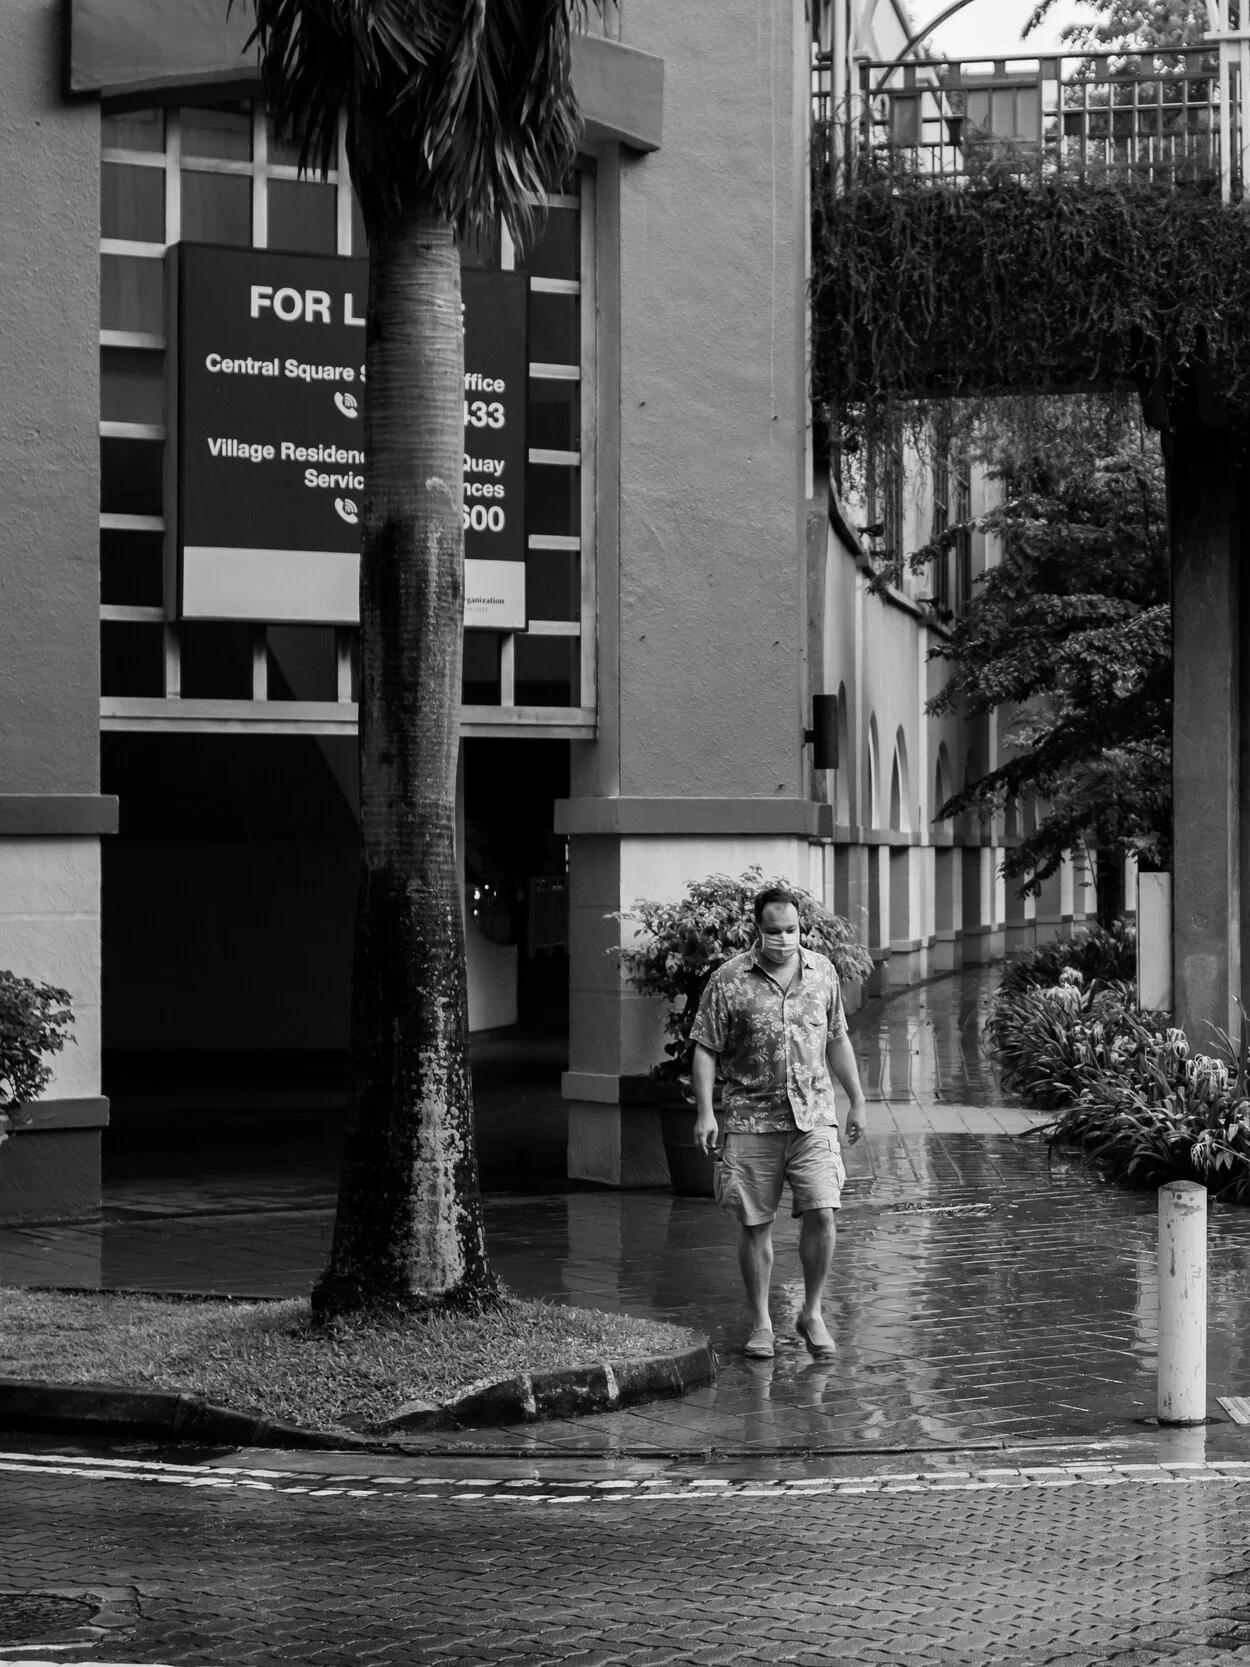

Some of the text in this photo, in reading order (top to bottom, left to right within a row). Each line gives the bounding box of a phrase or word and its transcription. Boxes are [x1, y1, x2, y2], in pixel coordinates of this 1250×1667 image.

[250, 285, 331, 324] FOR
[205, 353, 279, 376] Central
[284, 358, 355, 382] Square
[463, 372, 505, 393] ffice
[207, 437, 275, 463] Village
[280, 441, 365, 464] Residen
[304, 469, 365, 490] Servic
[465, 595, 505, 605] ganization
